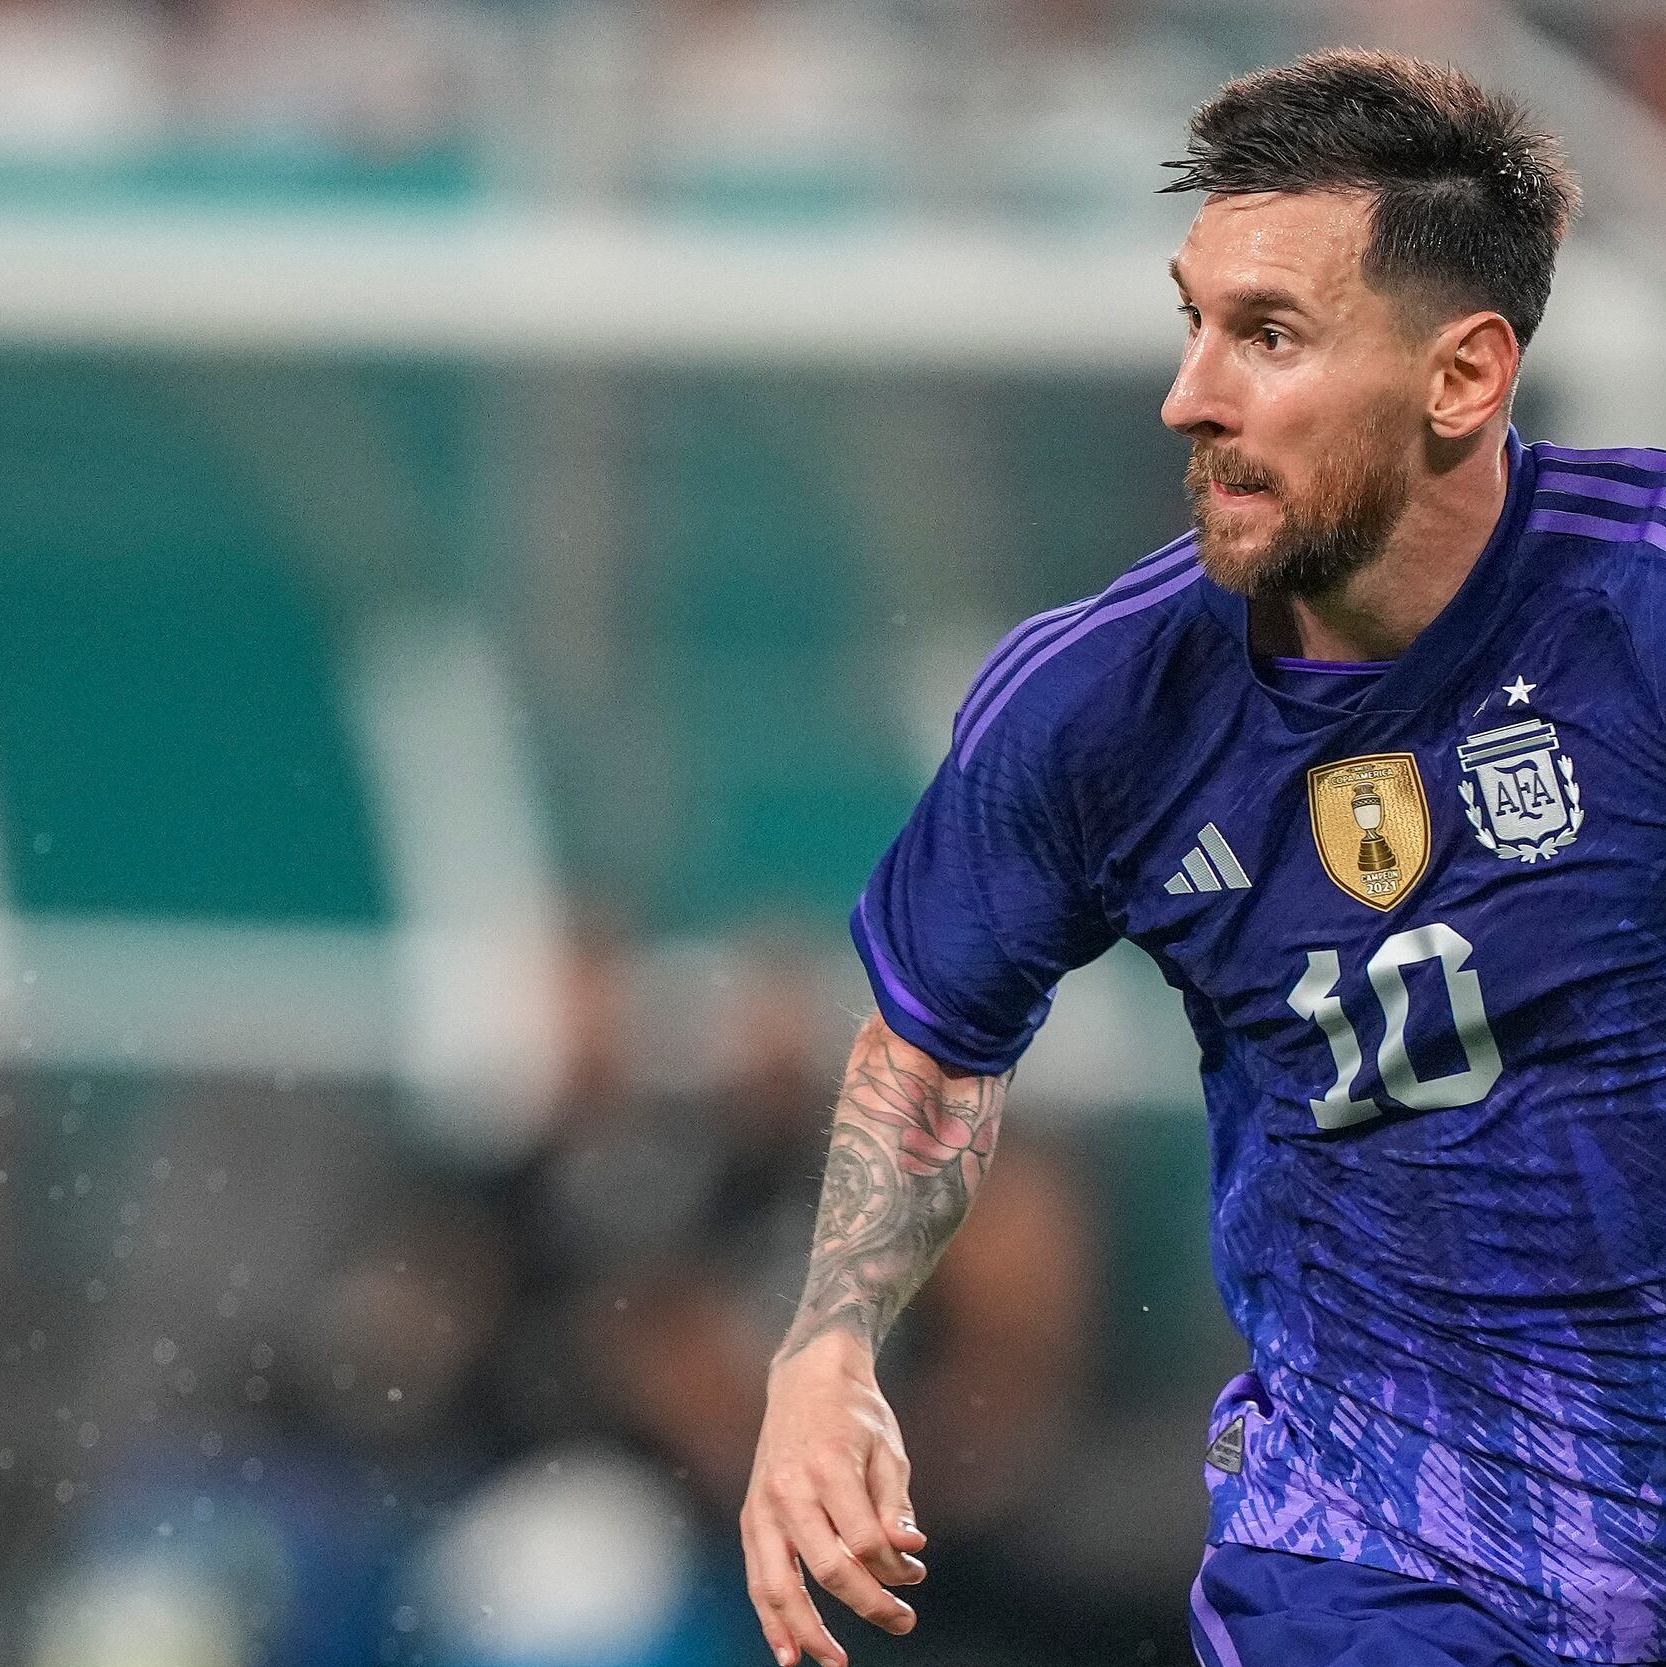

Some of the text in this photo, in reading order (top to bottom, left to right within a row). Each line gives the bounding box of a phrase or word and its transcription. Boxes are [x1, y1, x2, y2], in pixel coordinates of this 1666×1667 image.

[1331, 774, 1354, 786] COPA
[1493, 759, 1556, 820] AFA
[1367, 880, 1397, 895] 2021
[1286, 922, 1504, 1130] 10
